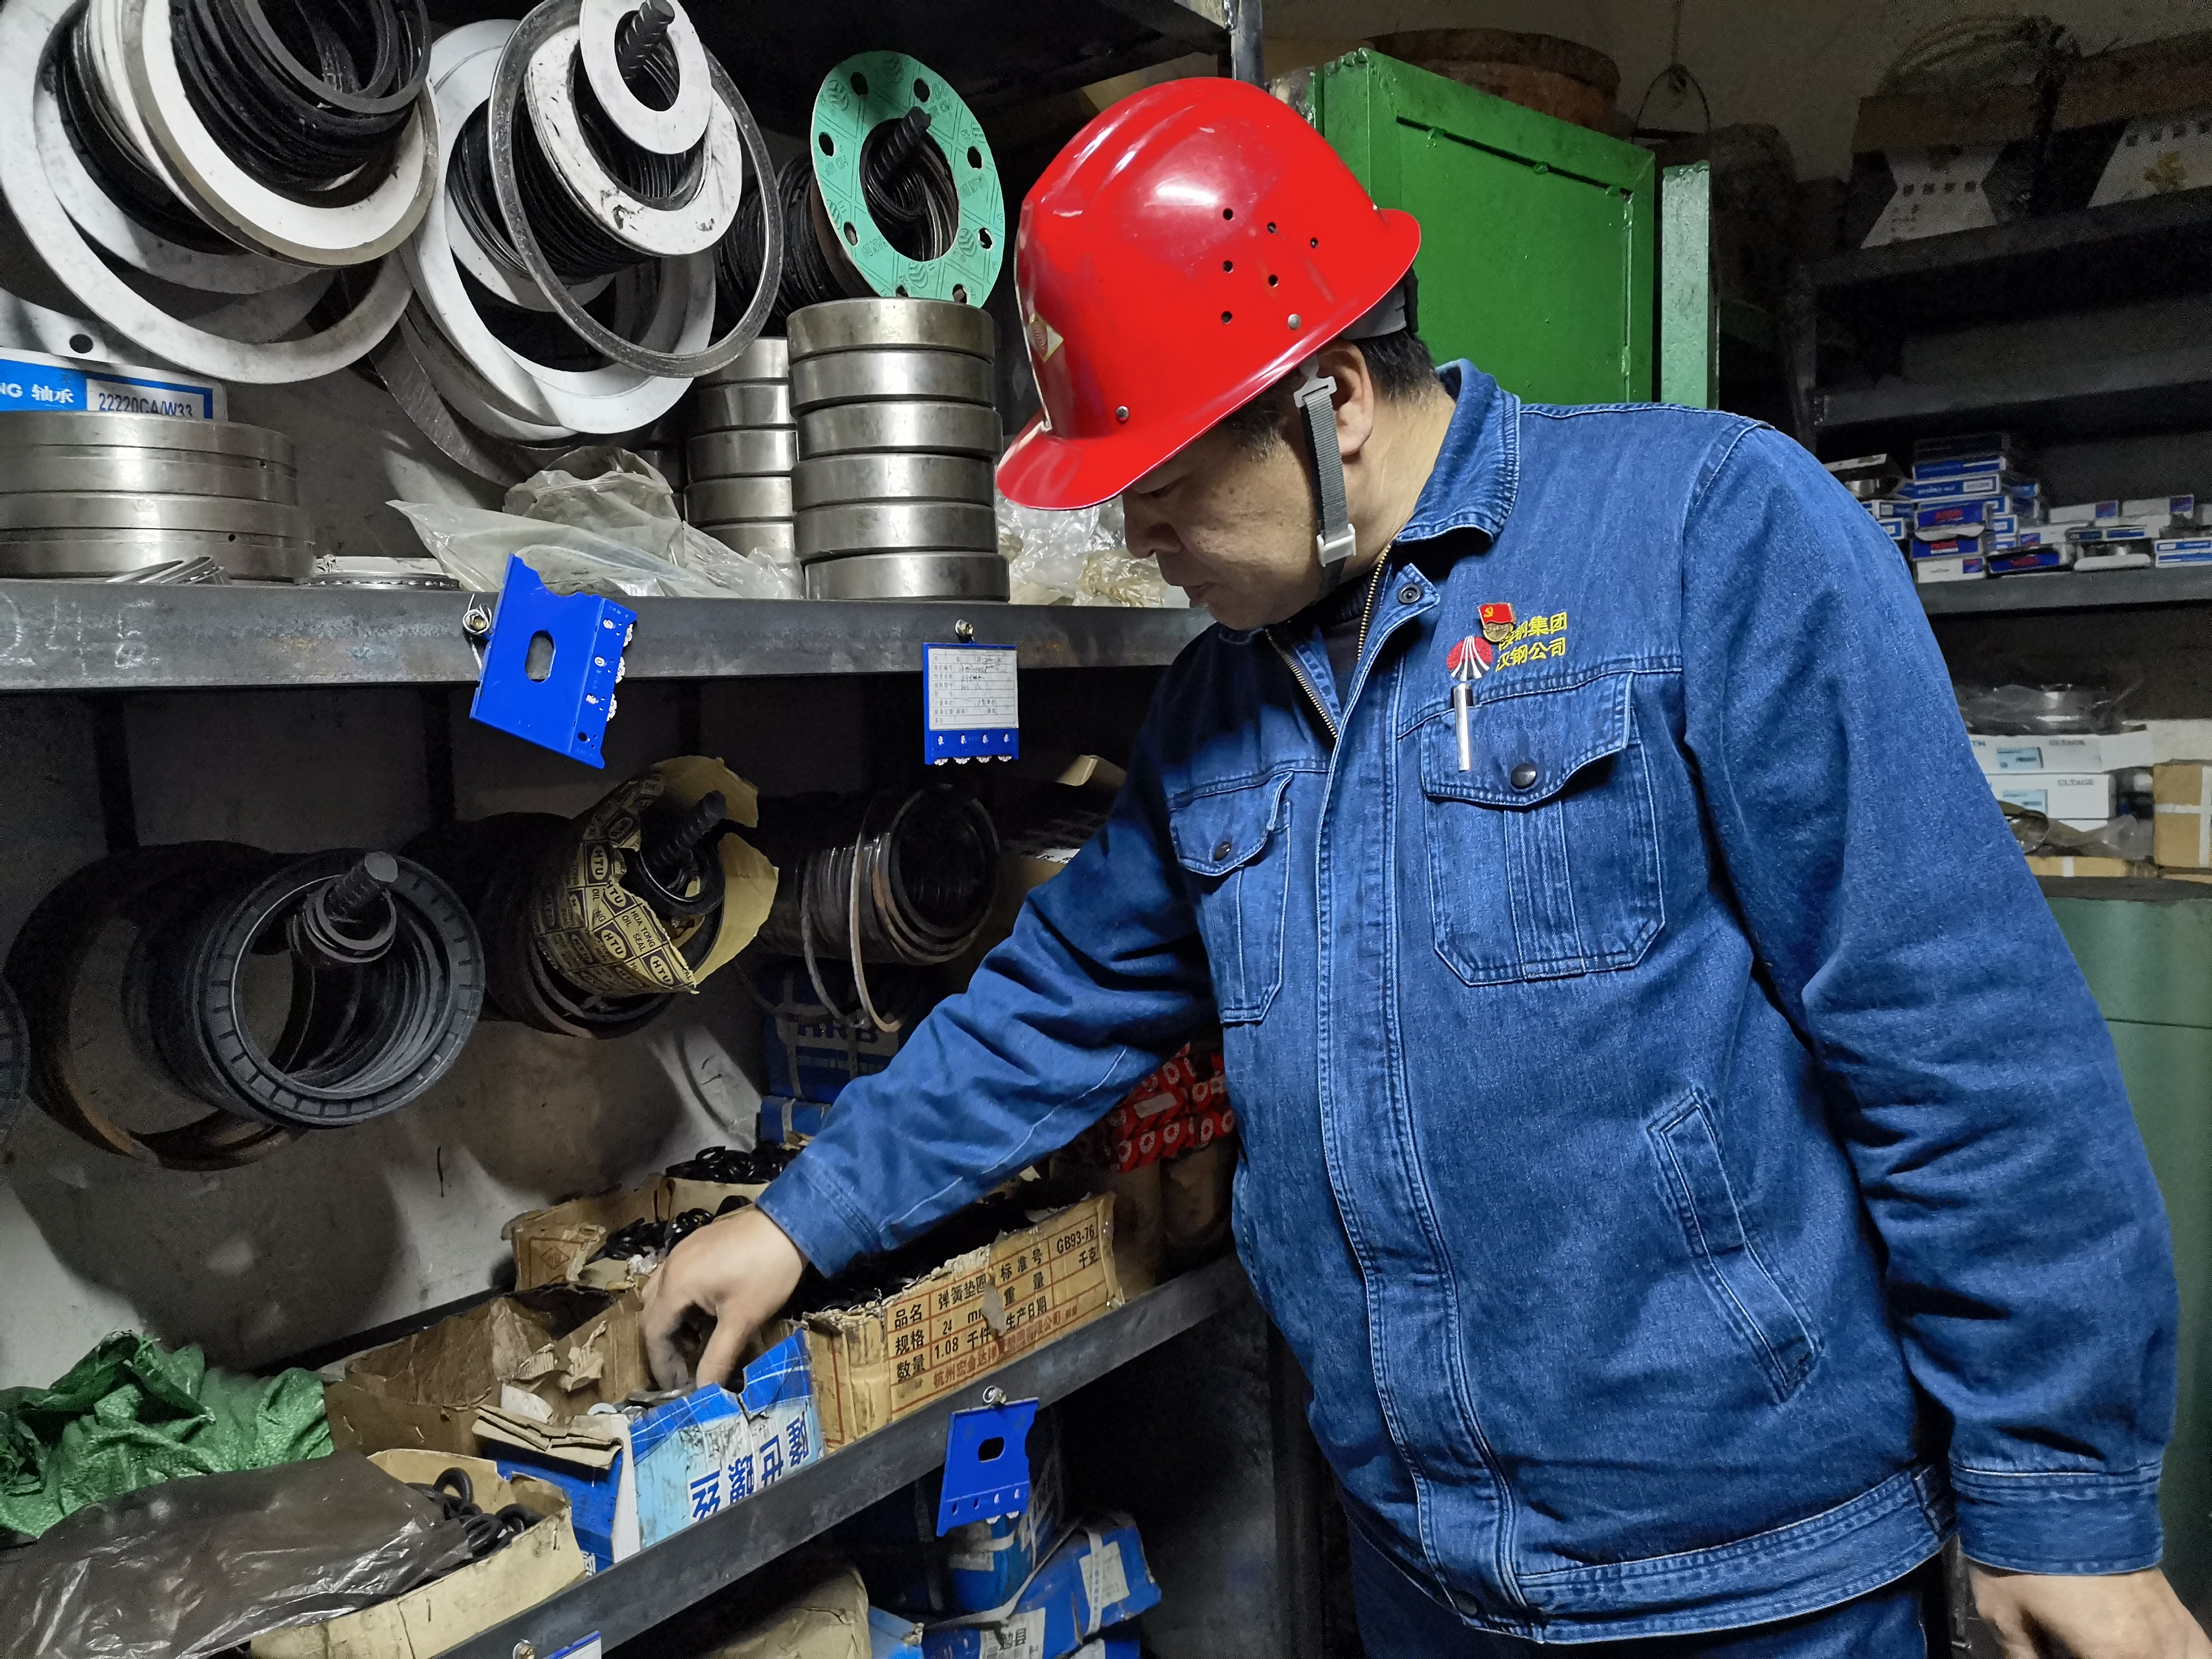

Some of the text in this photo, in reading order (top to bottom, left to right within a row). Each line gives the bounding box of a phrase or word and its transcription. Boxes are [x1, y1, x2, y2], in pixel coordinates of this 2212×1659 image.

[31, 384, 74, 404] 轴承
[1495, 637, 1566, 672] 汉钢公司
[595, 849, 605, 876] HTU
[592, 888, 600, 901] OIL
[606, 880, 625, 904] HTU
[604, 933, 624, 955] HTU
[622, 915, 645, 952] OIL SEAL
[630, 910, 656, 948] HUA TONG
[653, 960, 671, 983] HTU
[895, 1304, 923, 1329] 品名
[938, 1273, 987, 1310] 弹簧垫圈
[1001, 1249, 1043, 1282] 标准号
[895, 1331, 925, 1355] 规格
[943, 1320, 953, 1335] 24
[1078, 1245, 1098, 1269] 千克
[897, 1295, 1048, 1382] 数量 1.08 千件 生产日期
